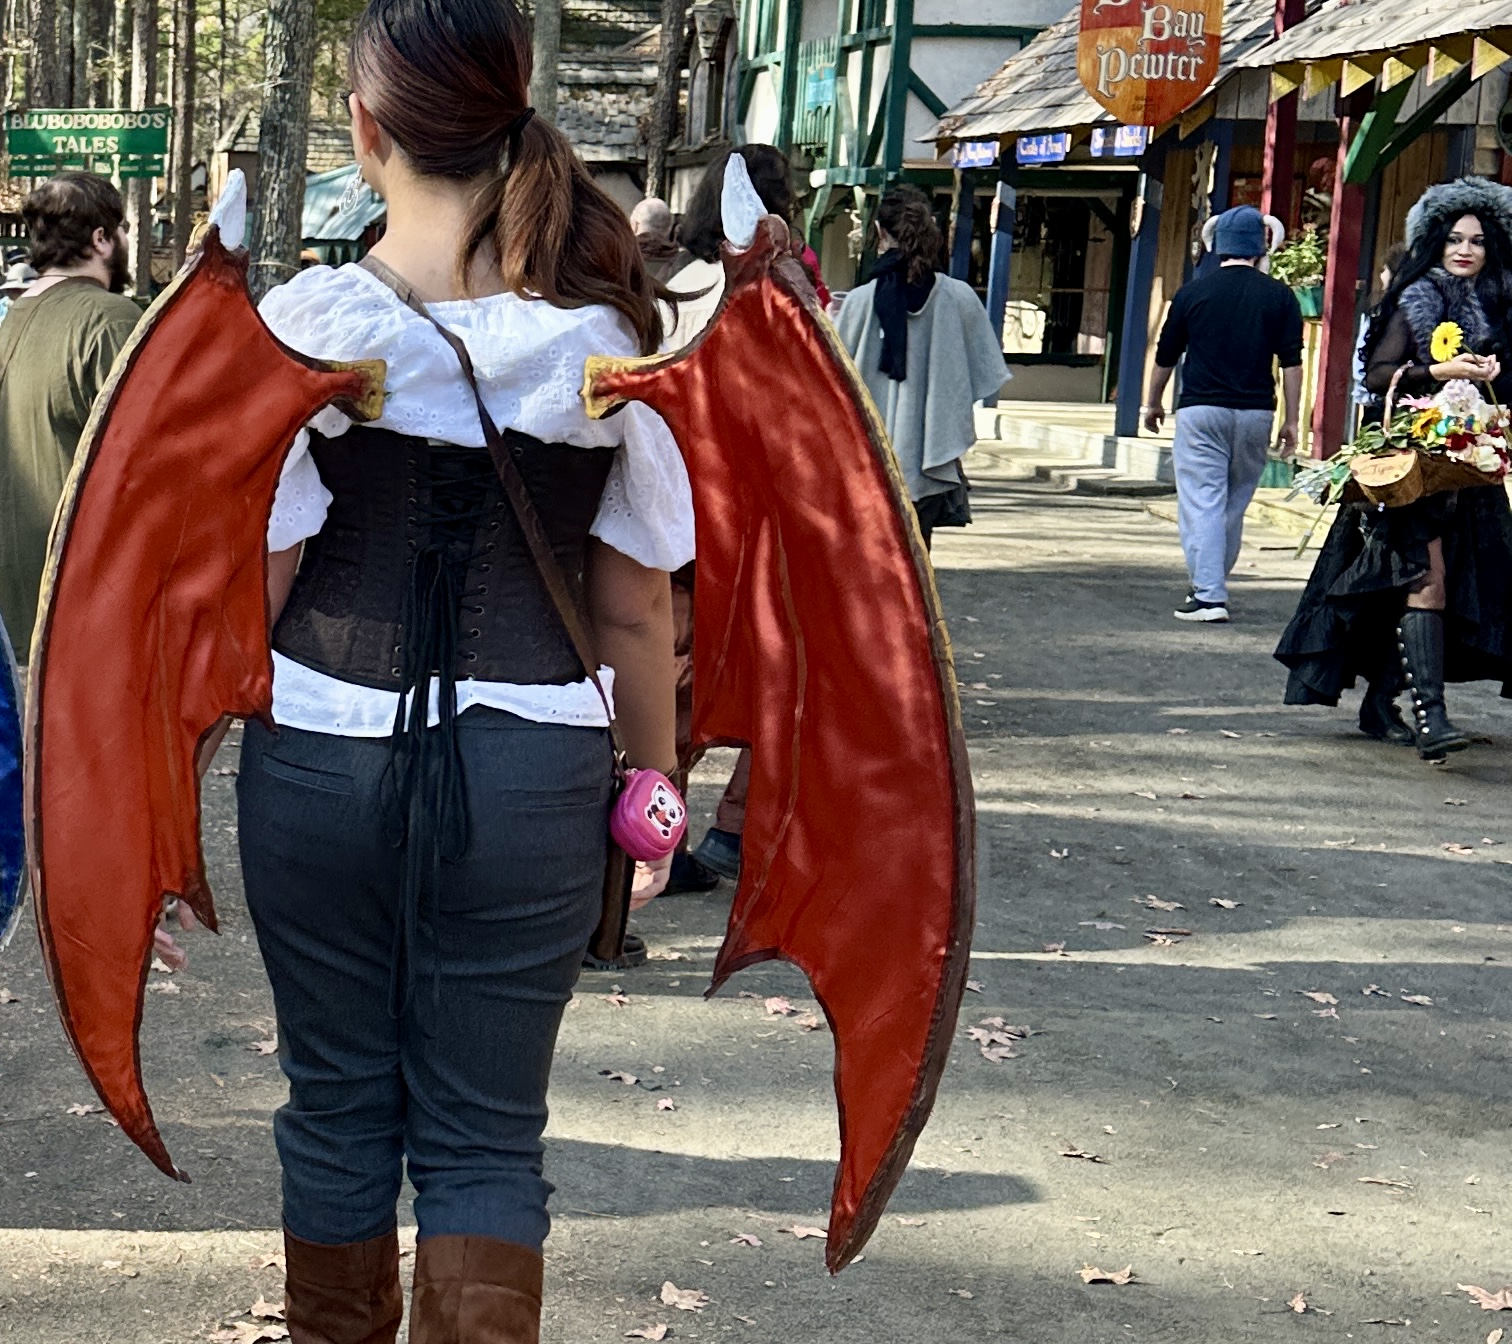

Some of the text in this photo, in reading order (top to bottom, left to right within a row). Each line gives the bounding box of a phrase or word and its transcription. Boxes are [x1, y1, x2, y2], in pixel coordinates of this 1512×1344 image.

[1138, 1, 1206, 47] Bay
[1096, 45, 1204, 99] Pewter
[52, 136, 119, 153] TALES
